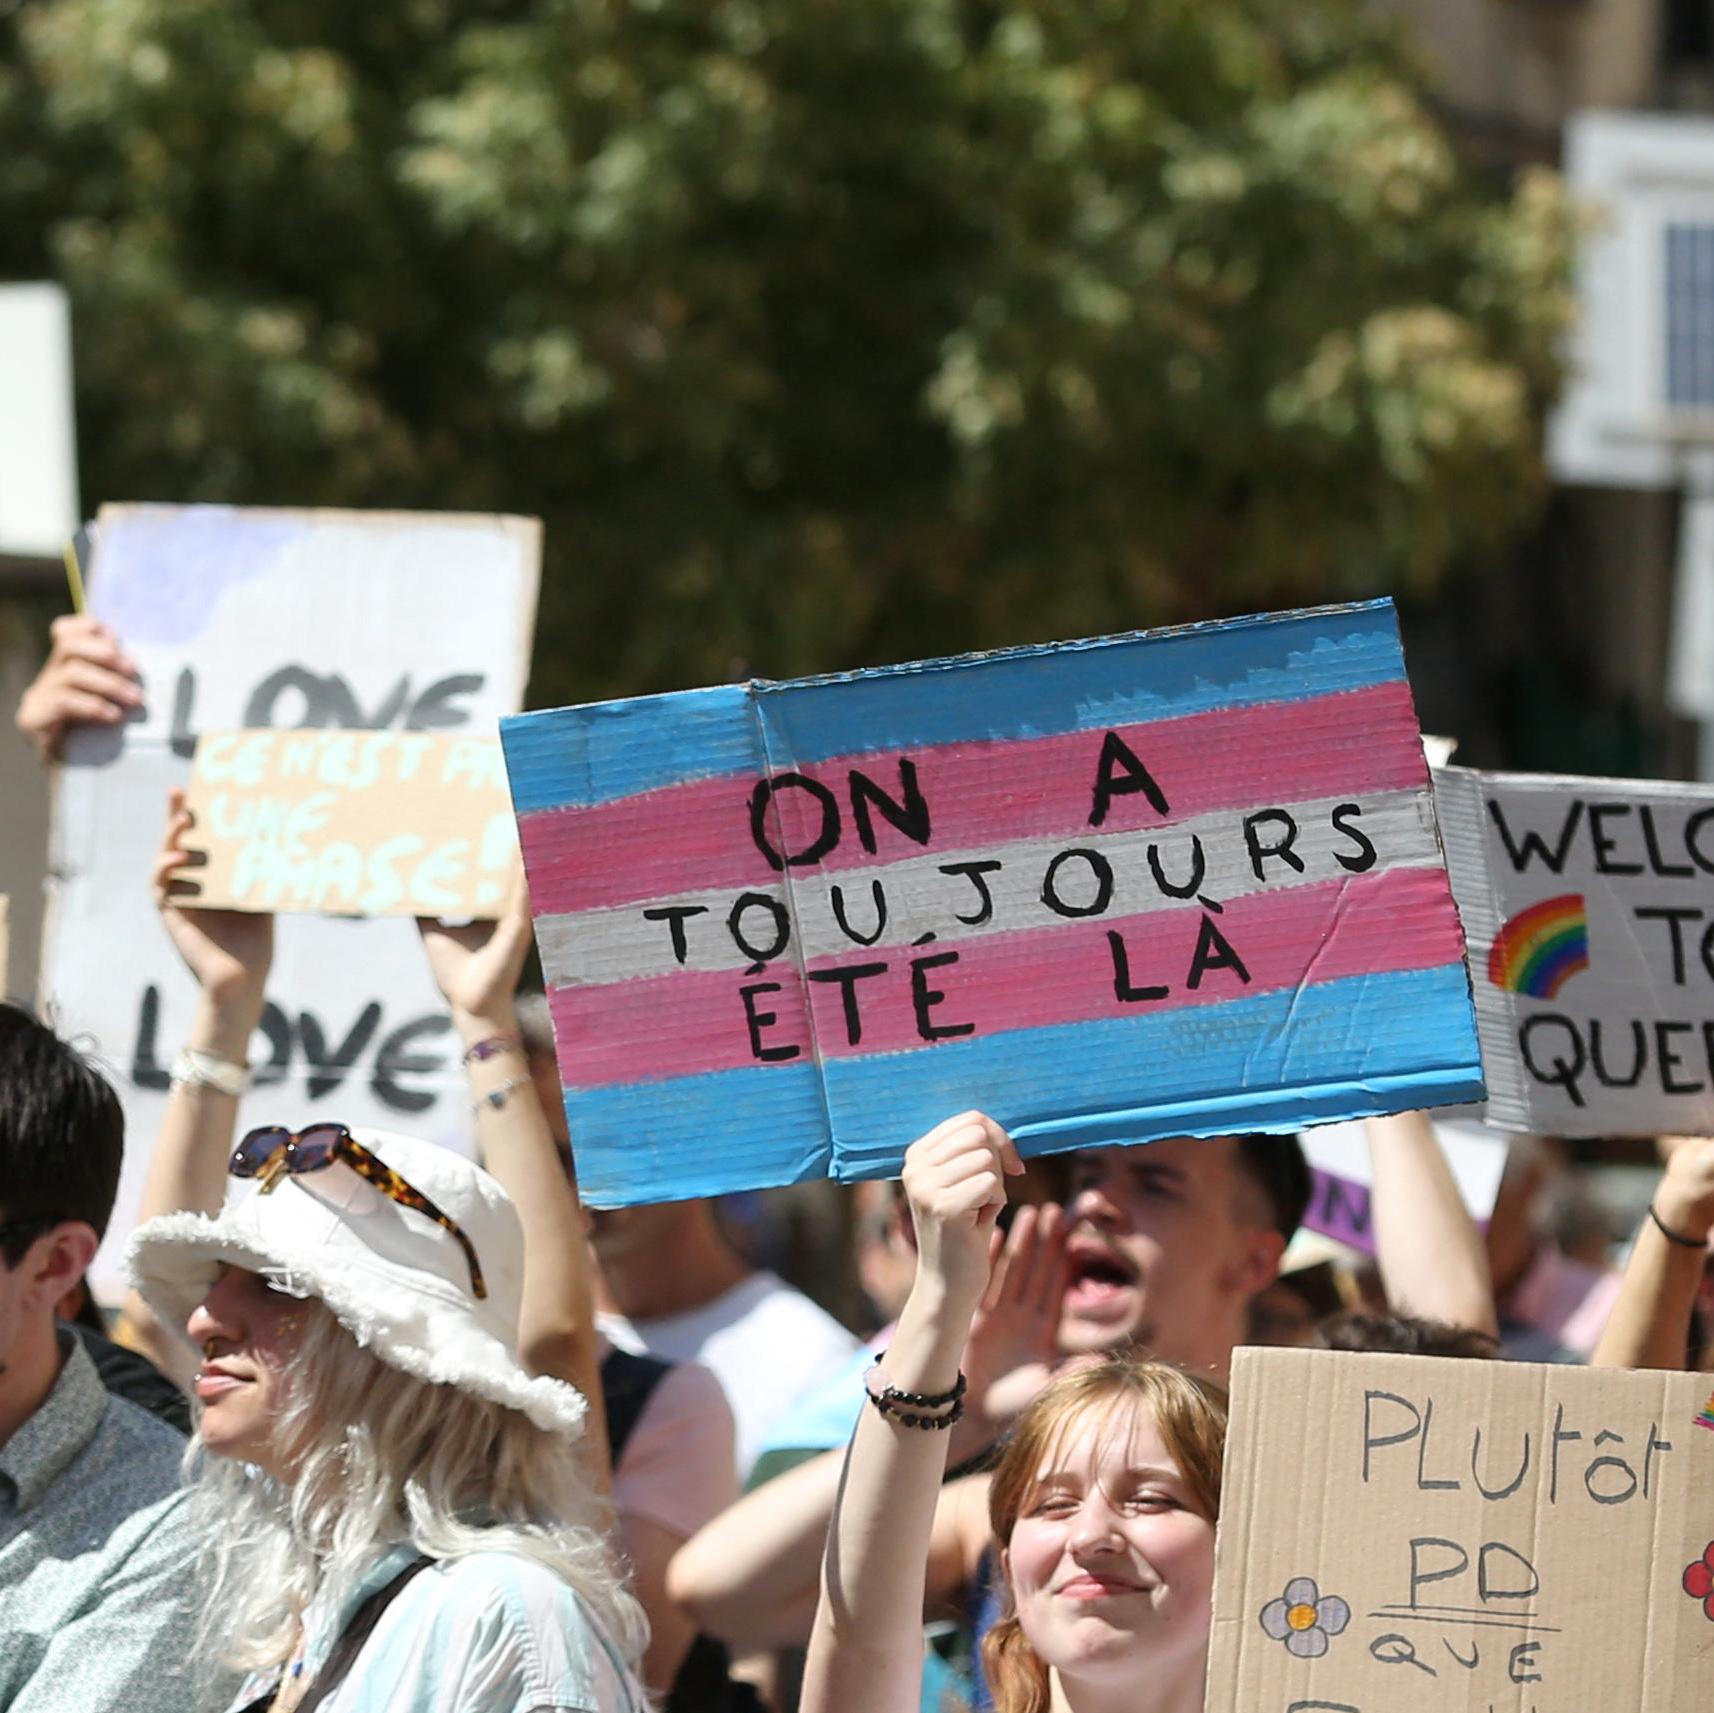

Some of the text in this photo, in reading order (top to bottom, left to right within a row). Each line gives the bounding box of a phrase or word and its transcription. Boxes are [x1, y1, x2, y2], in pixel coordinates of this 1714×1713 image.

[748, 730, 1171, 872] ON A
[642, 801, 1378, 965] TOUJOURS
[738, 895, 1252, 1063] ÉTÉ LÀ
[1408, 1537, 1540, 1610] PD
[1368, 1632, 1543, 1684] QUE
